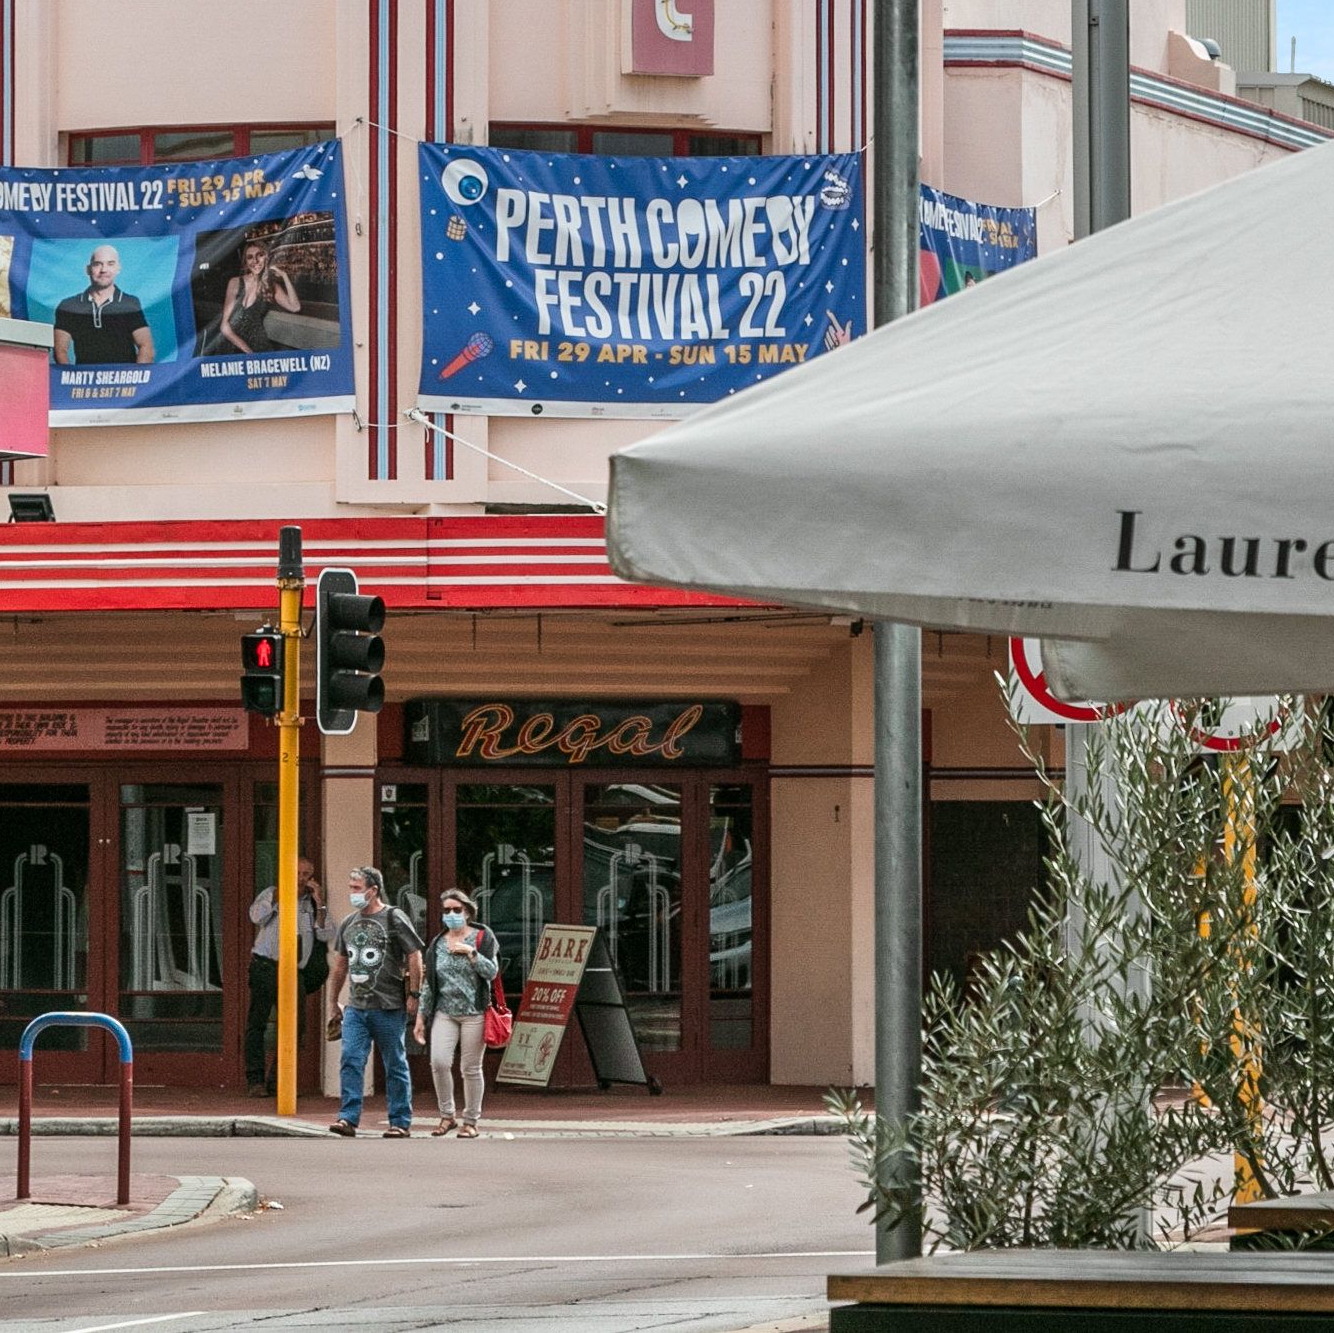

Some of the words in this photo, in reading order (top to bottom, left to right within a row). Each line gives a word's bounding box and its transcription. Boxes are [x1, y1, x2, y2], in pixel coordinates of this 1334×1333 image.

[167, 178, 195, 194] FRI
[201, 174, 225, 192] 29
[230, 168, 265, 188] APR
[179, 192, 216, 208] SUN
[222, 186, 240, 203] 15
[245, 180, 282, 199] MAY
[56, 182, 139, 212] FESTIVAL
[140, 179, 163, 210] 22
[496, 188, 642, 267] PERTH
[646, 195, 815, 269] COMEDY
[535, 269, 729, 340] FESTIVAL
[738, 271, 787, 338] 22
[510, 340, 549, 361] FRI
[558, 342, 590, 363] 29
[597, 344, 648, 364] APR
[669, 345, 716, 365] SUN
[724, 344, 752, 363] 15
[758, 343, 809, 363] MAY
[61, 370, 94, 385] MARTY
[95, 370, 151, 385] SHEARGOLD
[201, 361, 244, 378] MELANIE
[246, 358, 308, 375] BRACEWELL
[310, 354, 331, 372] (NZ)
[71, 387, 84, 399] FRI
[99, 387, 113, 398] SAT
[121, 387, 136, 398] MAY
[247, 377, 264, 389] SAT
[271, 376, 288, 388] MAY
[456, 703, 704, 764] Regal
[539, 937, 588, 963] BARK
[531, 987, 550, 1003] 20%
[550, 989, 567, 1004] OFF
